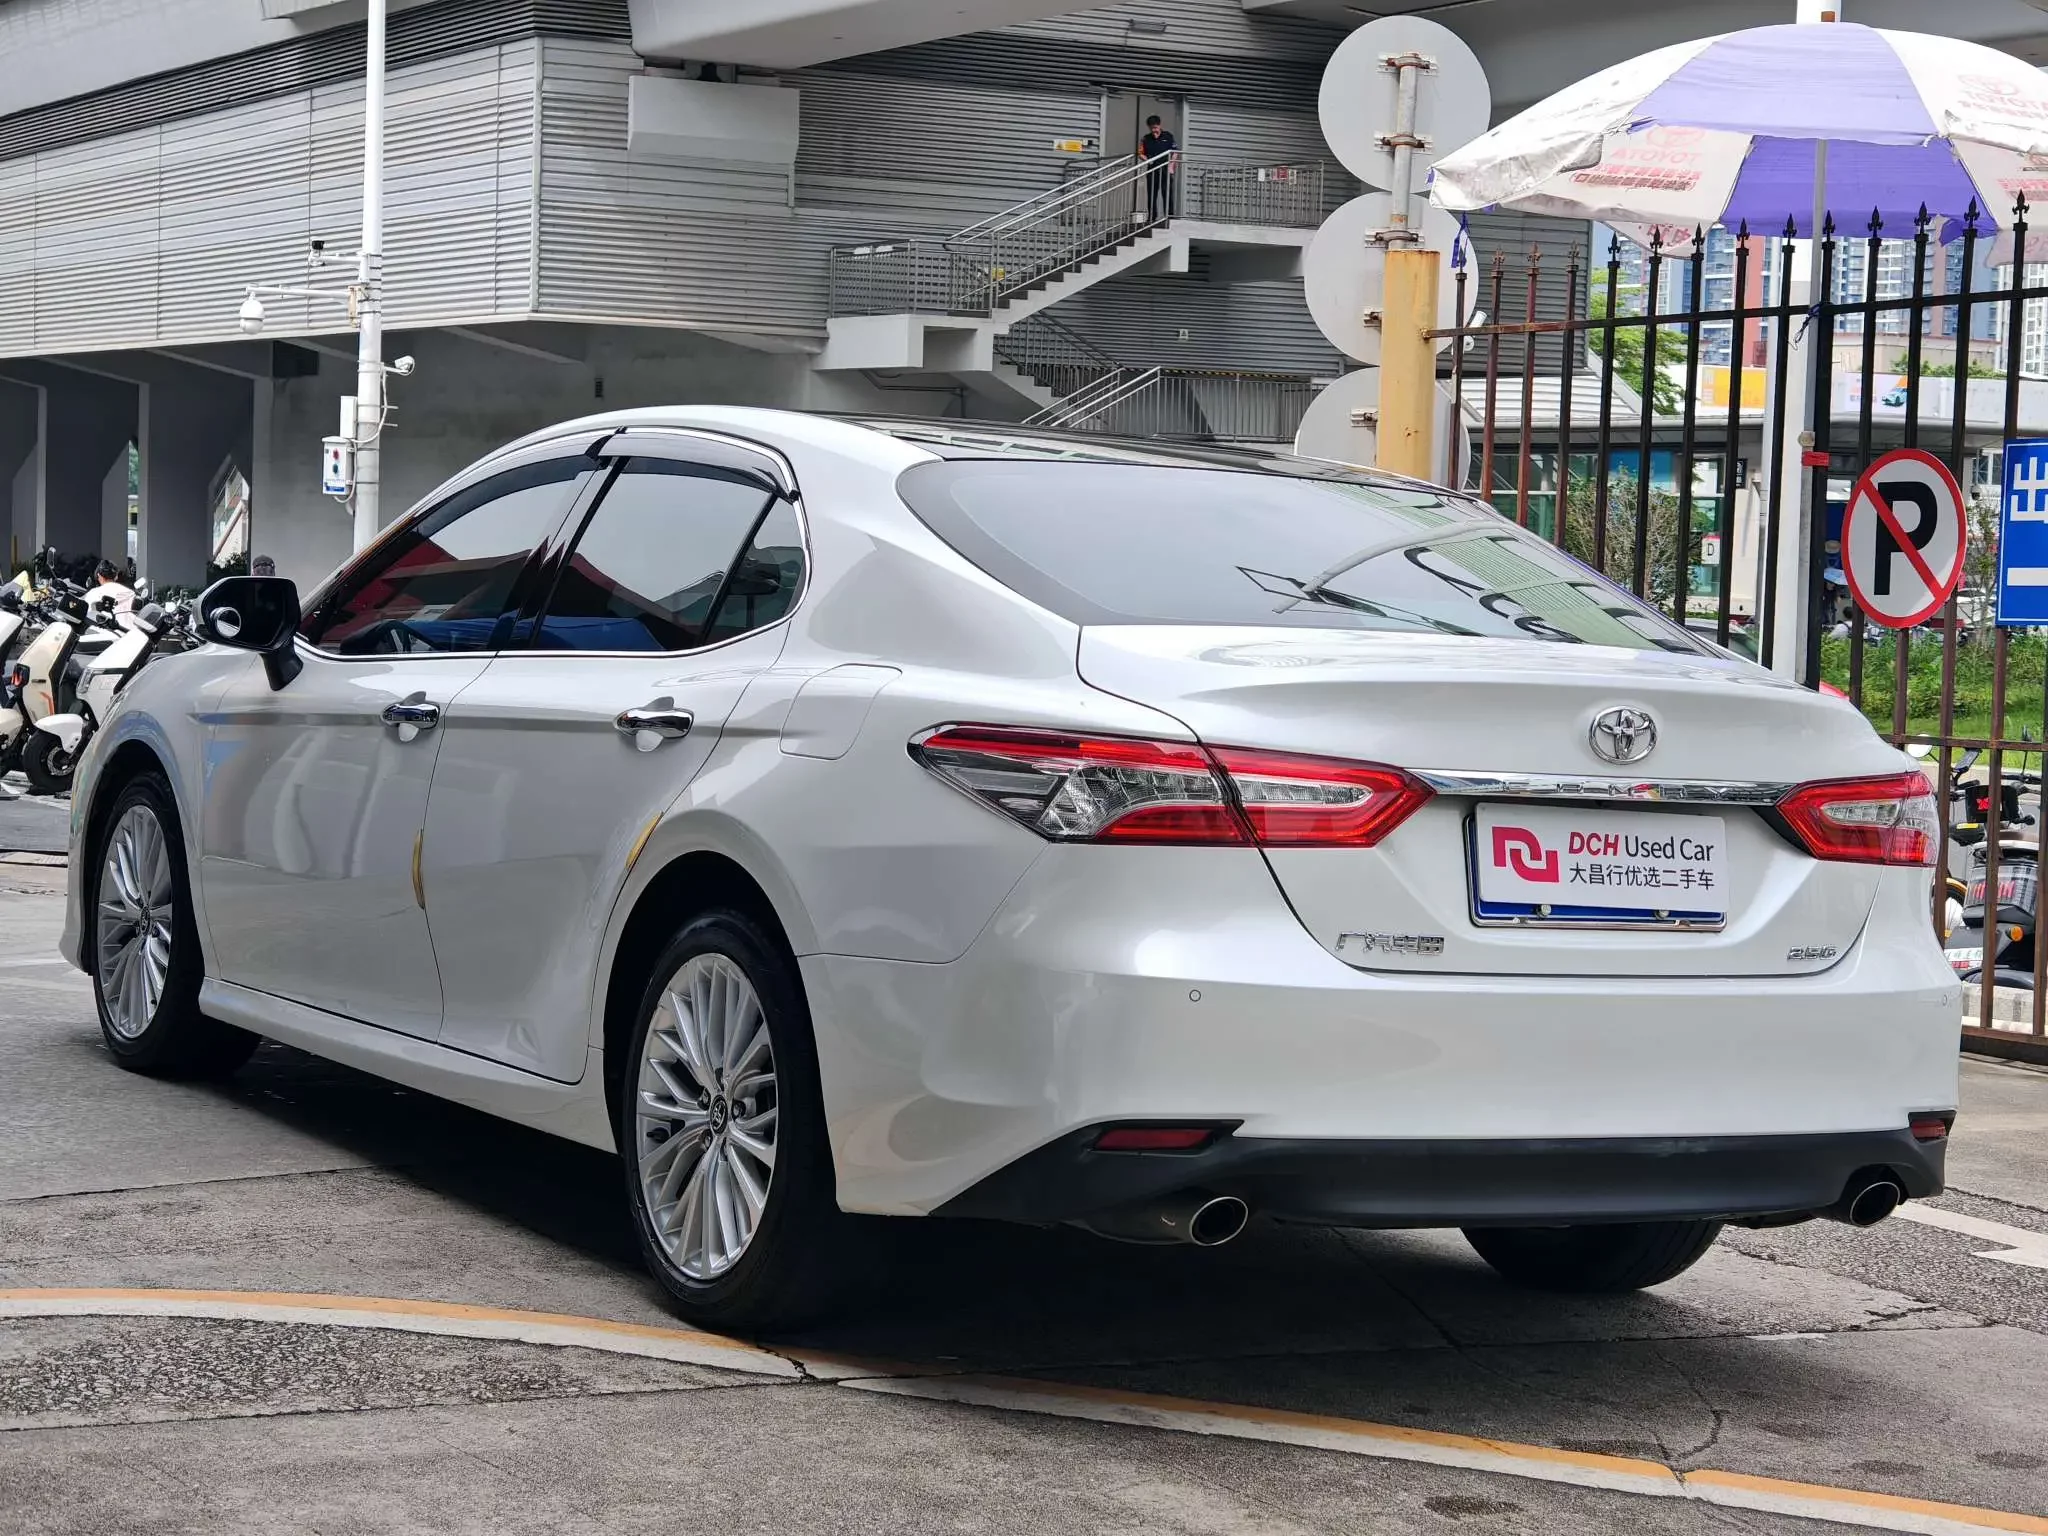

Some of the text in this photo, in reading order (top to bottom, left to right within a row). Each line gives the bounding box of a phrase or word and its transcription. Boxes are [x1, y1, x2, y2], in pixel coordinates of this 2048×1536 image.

[1874, 481, 1938, 596] P
[1568, 831, 1715, 862] DCH Used Car
[1569, 861, 1716, 891] 大昌行优选二手车
